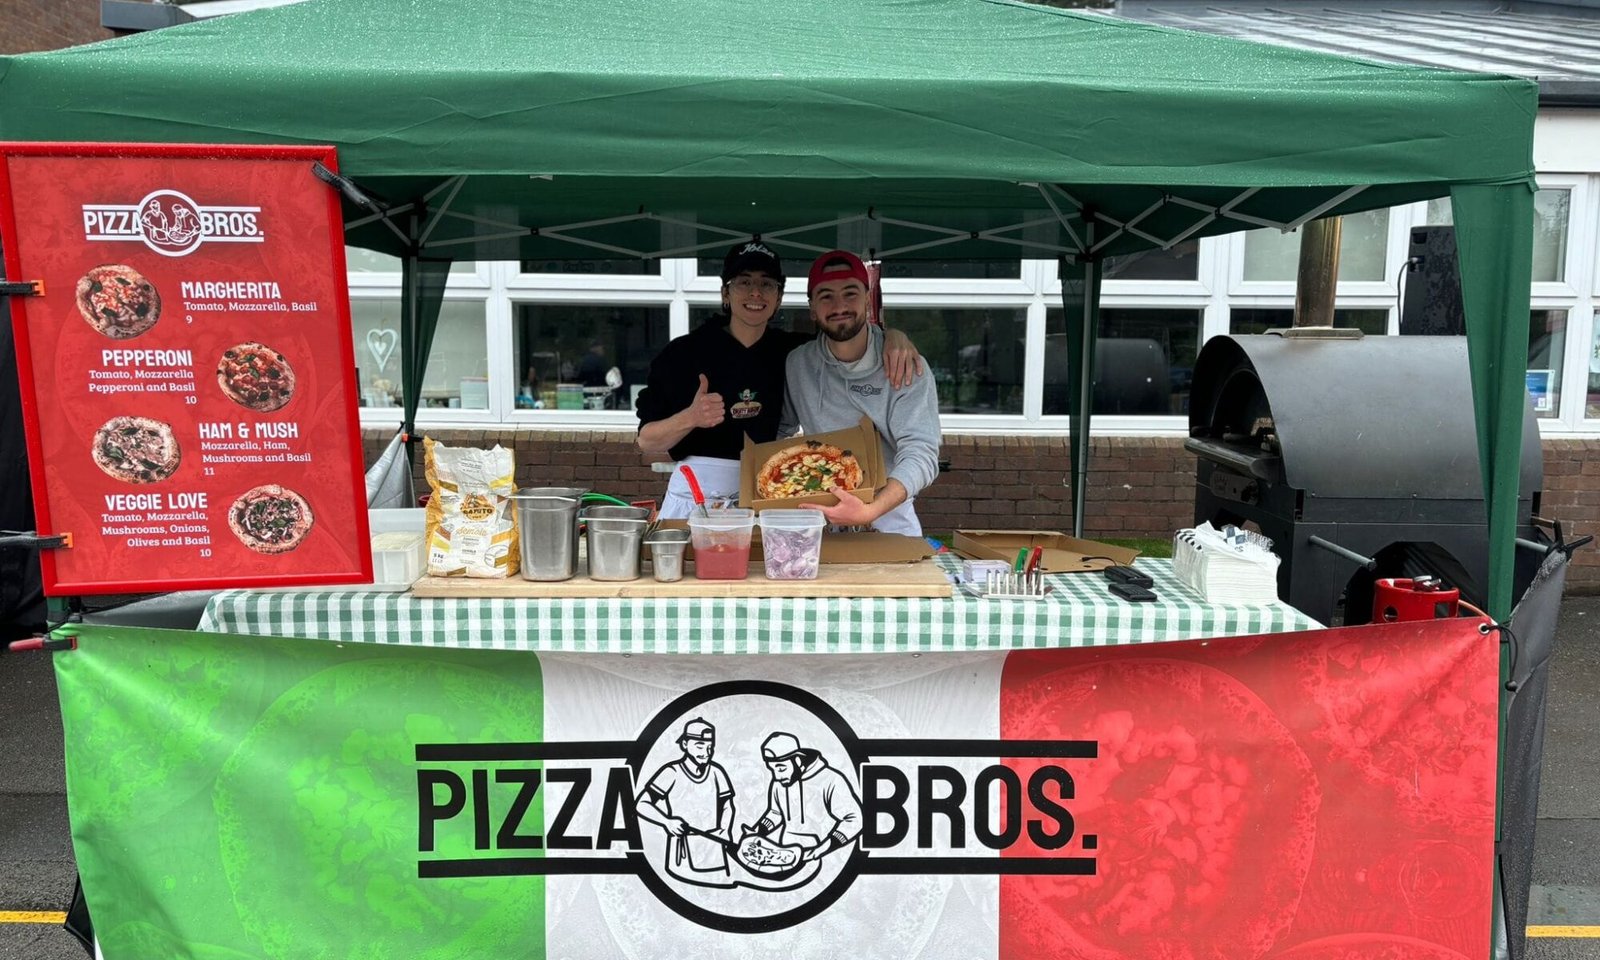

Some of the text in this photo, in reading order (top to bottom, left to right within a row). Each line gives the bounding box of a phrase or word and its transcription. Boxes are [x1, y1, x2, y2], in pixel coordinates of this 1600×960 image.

[83, 211, 264, 236] PIZZA BROS.
[181, 282, 281, 299] MARGHERITA
[184, 302, 317, 311] Tomato, Mozzarella, Basil
[186, 315, 192, 323] 9
[102, 350, 192, 366] PEPPERONI
[89, 370, 193, 379] Tomato, Mozzarella
[89, 382, 195, 394] Pepperoni and Basil
[186, 396, 196, 404] 10
[199, 422, 298, 439] HAM & MUSH
[202, 441, 290, 450] Mozzarella, Ham,
[203, 453, 311, 462] Mushrooms and Basil
[105, 493, 207, 511] VEGGIE LOVE
[102, 512, 208, 522] Tomato, Mozzarella,
[102, 524, 209, 535] Mushrooms, Onions,
[127, 536, 210, 547] Olives and Basil
[200, 549, 211, 557] 10
[417, 764, 1098, 852] PIZZA BROS.
